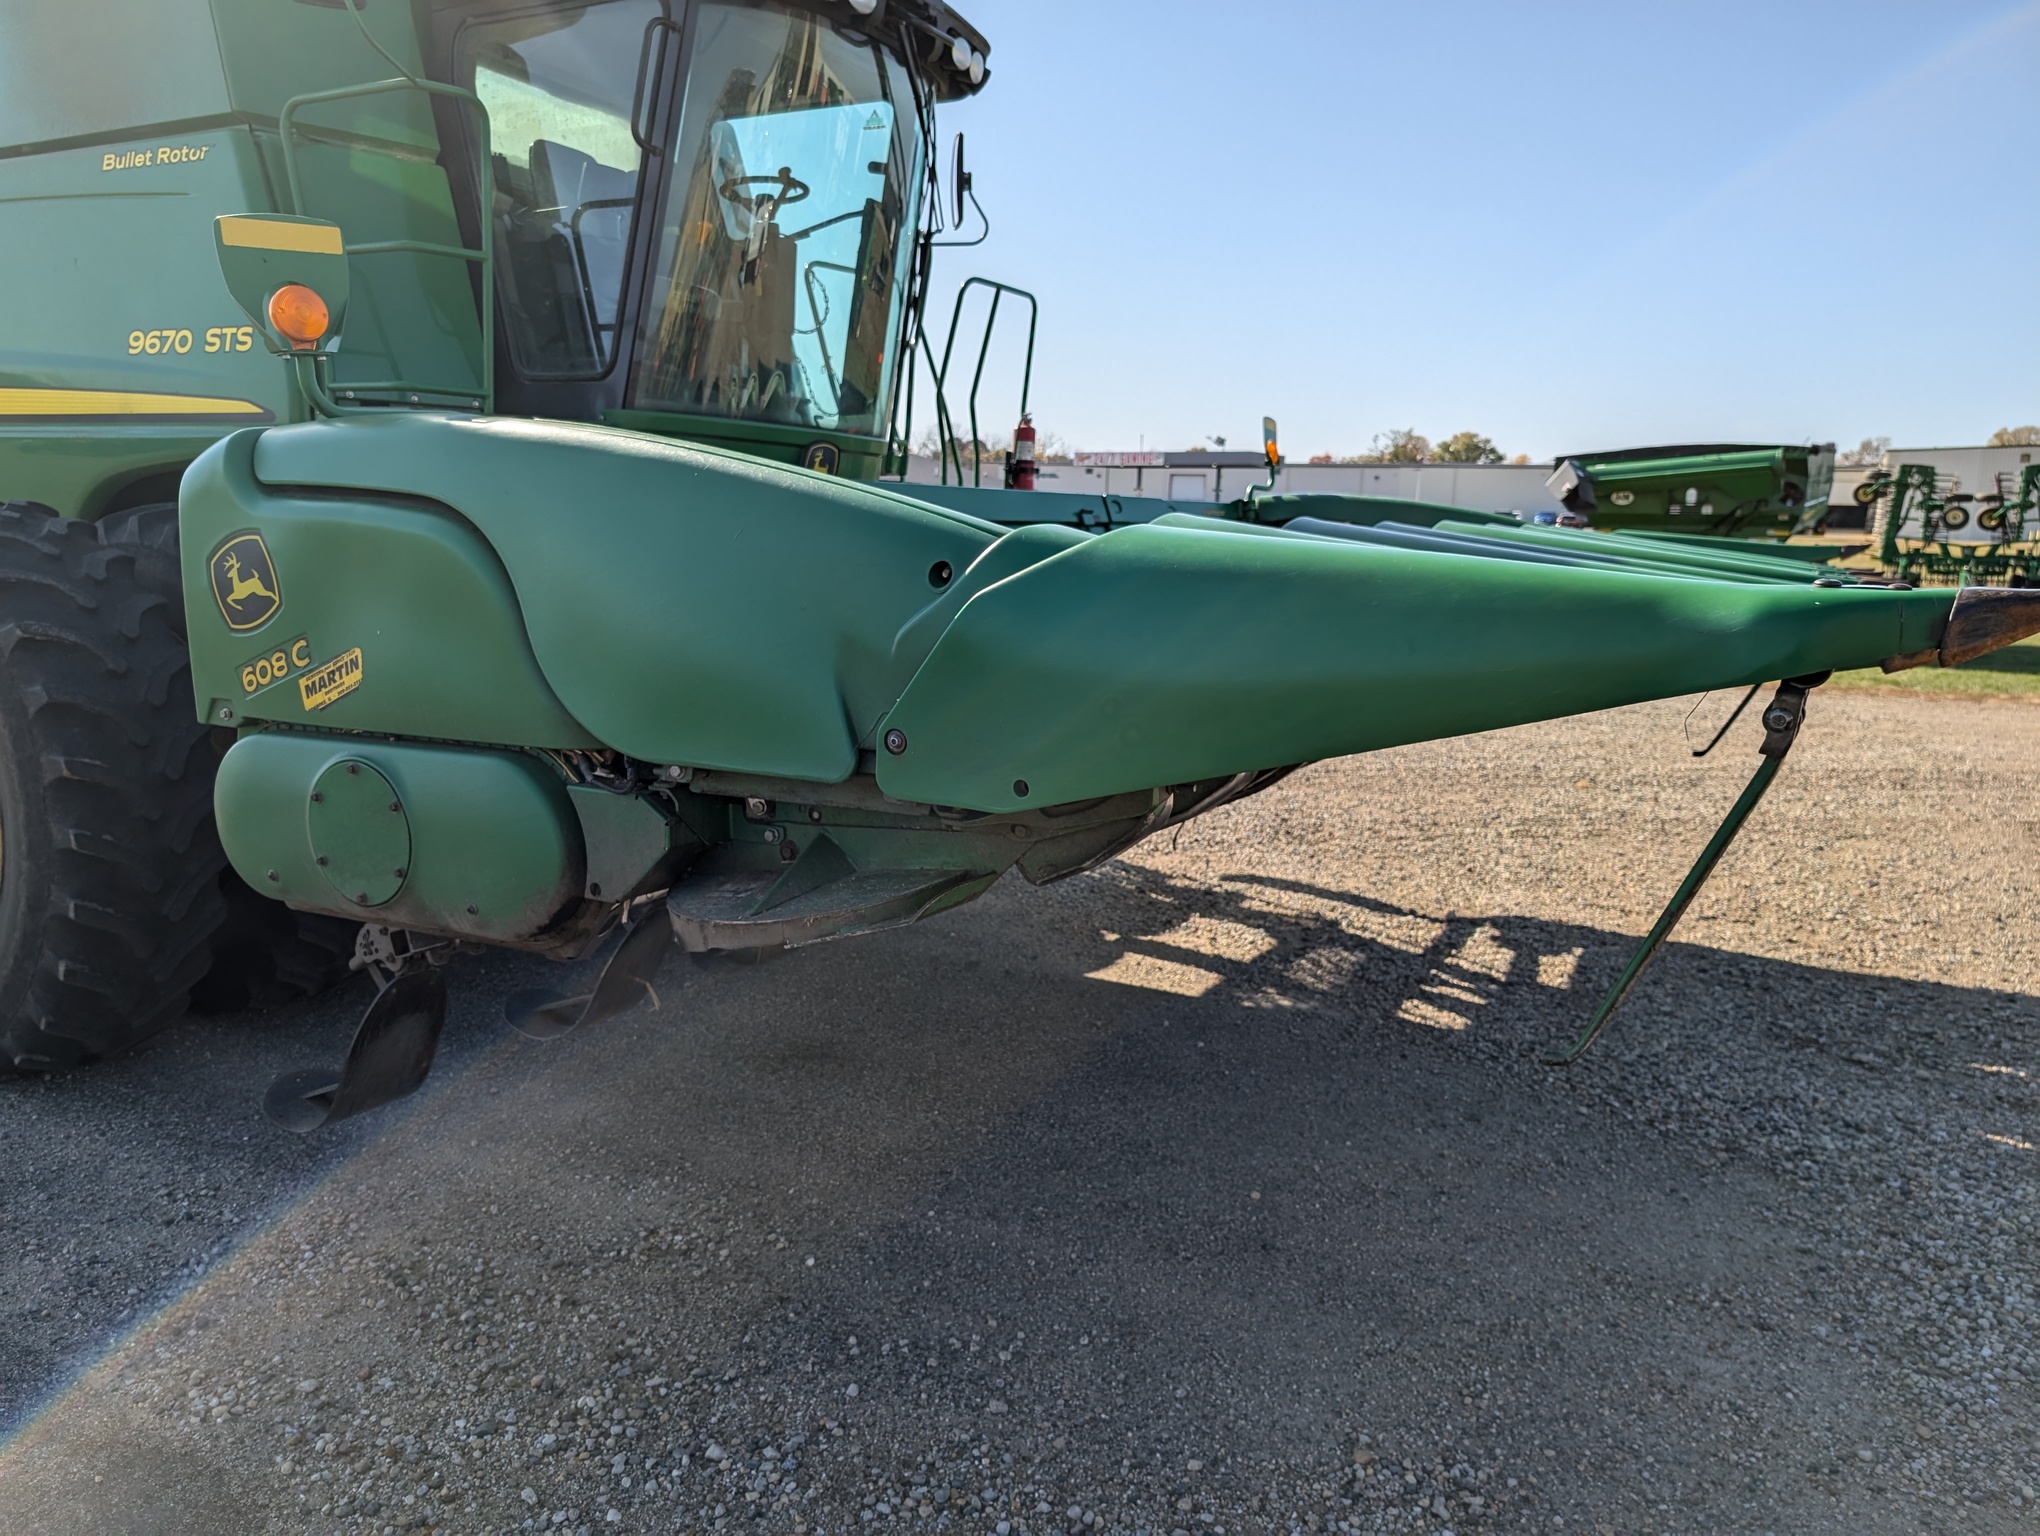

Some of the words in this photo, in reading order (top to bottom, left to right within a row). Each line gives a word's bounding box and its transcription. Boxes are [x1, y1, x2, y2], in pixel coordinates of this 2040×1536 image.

[102, 150, 153, 171] Bullet
[156, 145, 209, 165] Rotor
[128, 328, 193, 355] 9670
[204, 326, 253, 353] STS
[241, 650, 289, 693] 608
[291, 638, 311, 669] C
[304, 654, 360, 700] MARTIN
